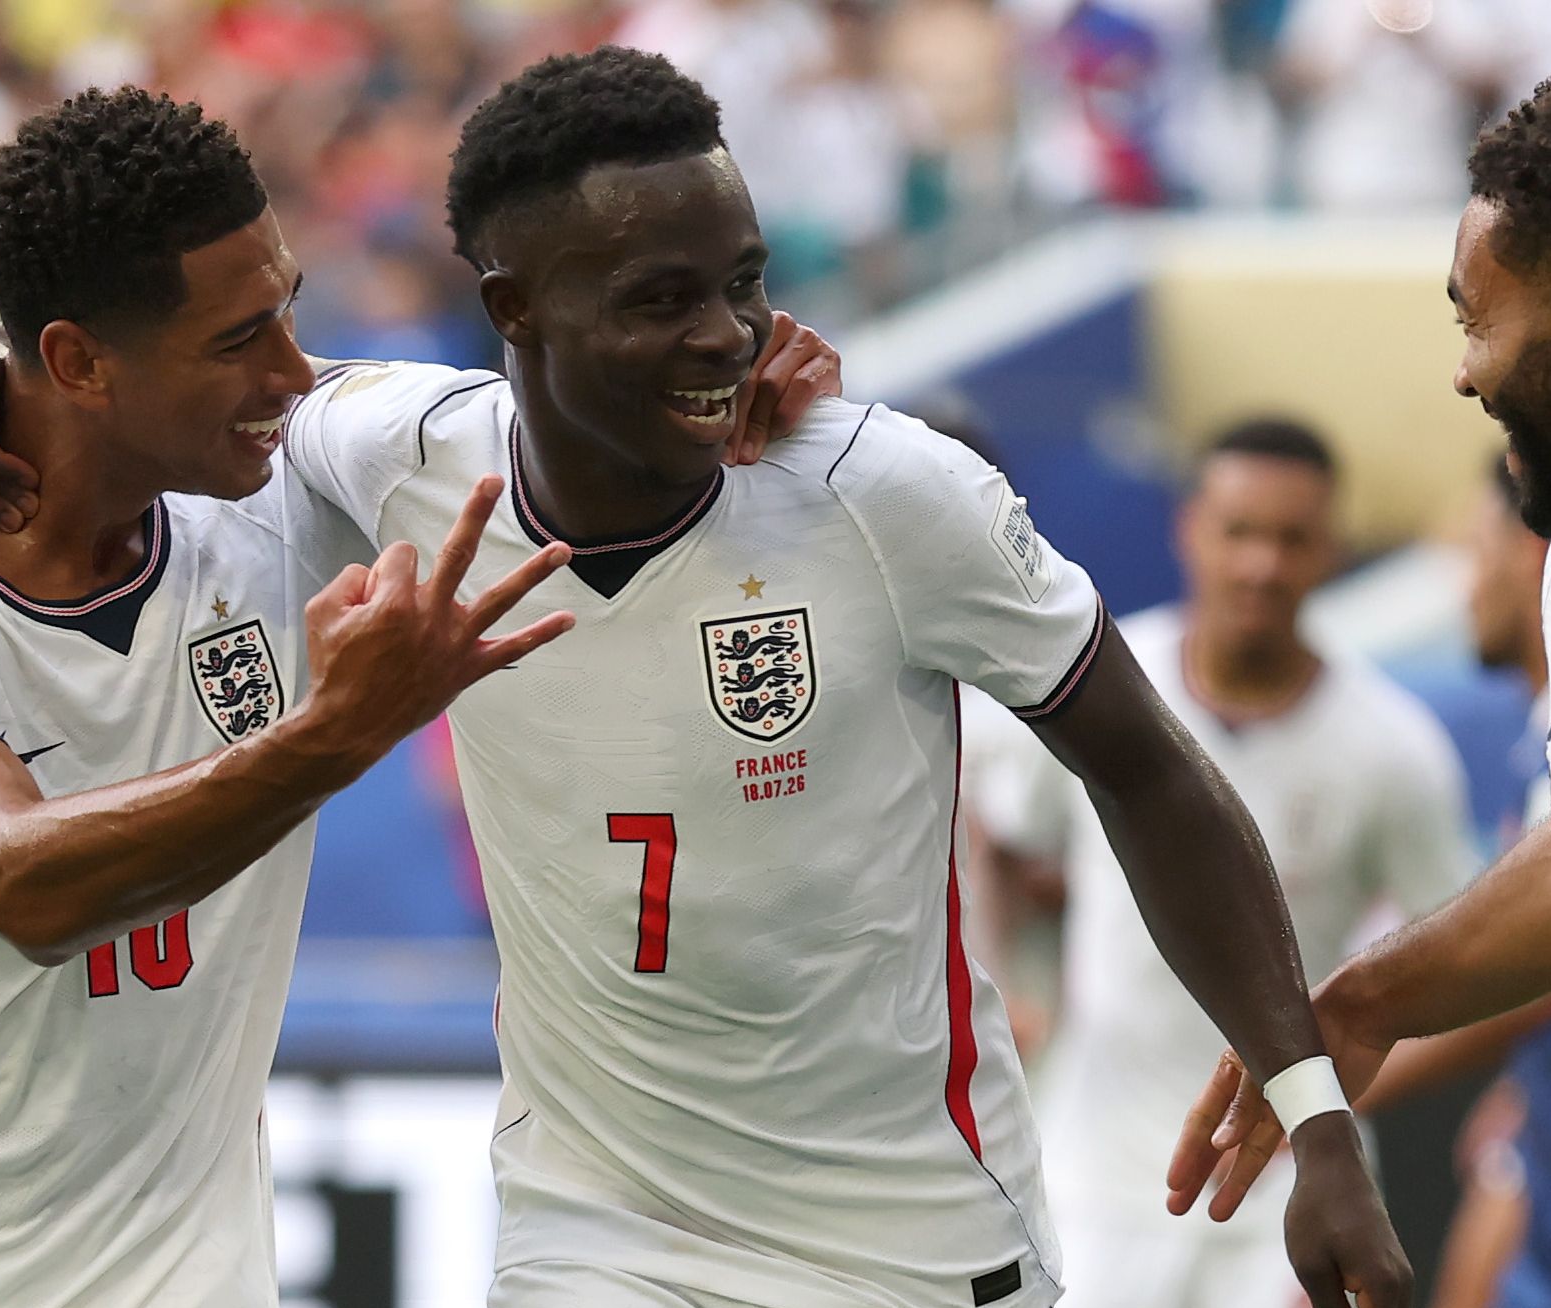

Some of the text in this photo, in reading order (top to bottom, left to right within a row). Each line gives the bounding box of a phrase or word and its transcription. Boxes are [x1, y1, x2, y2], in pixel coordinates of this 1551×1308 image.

[736, 749, 808, 779] FRANCE
[743, 774, 805, 803] 18.07.26
[606, 813, 678, 973] 7
